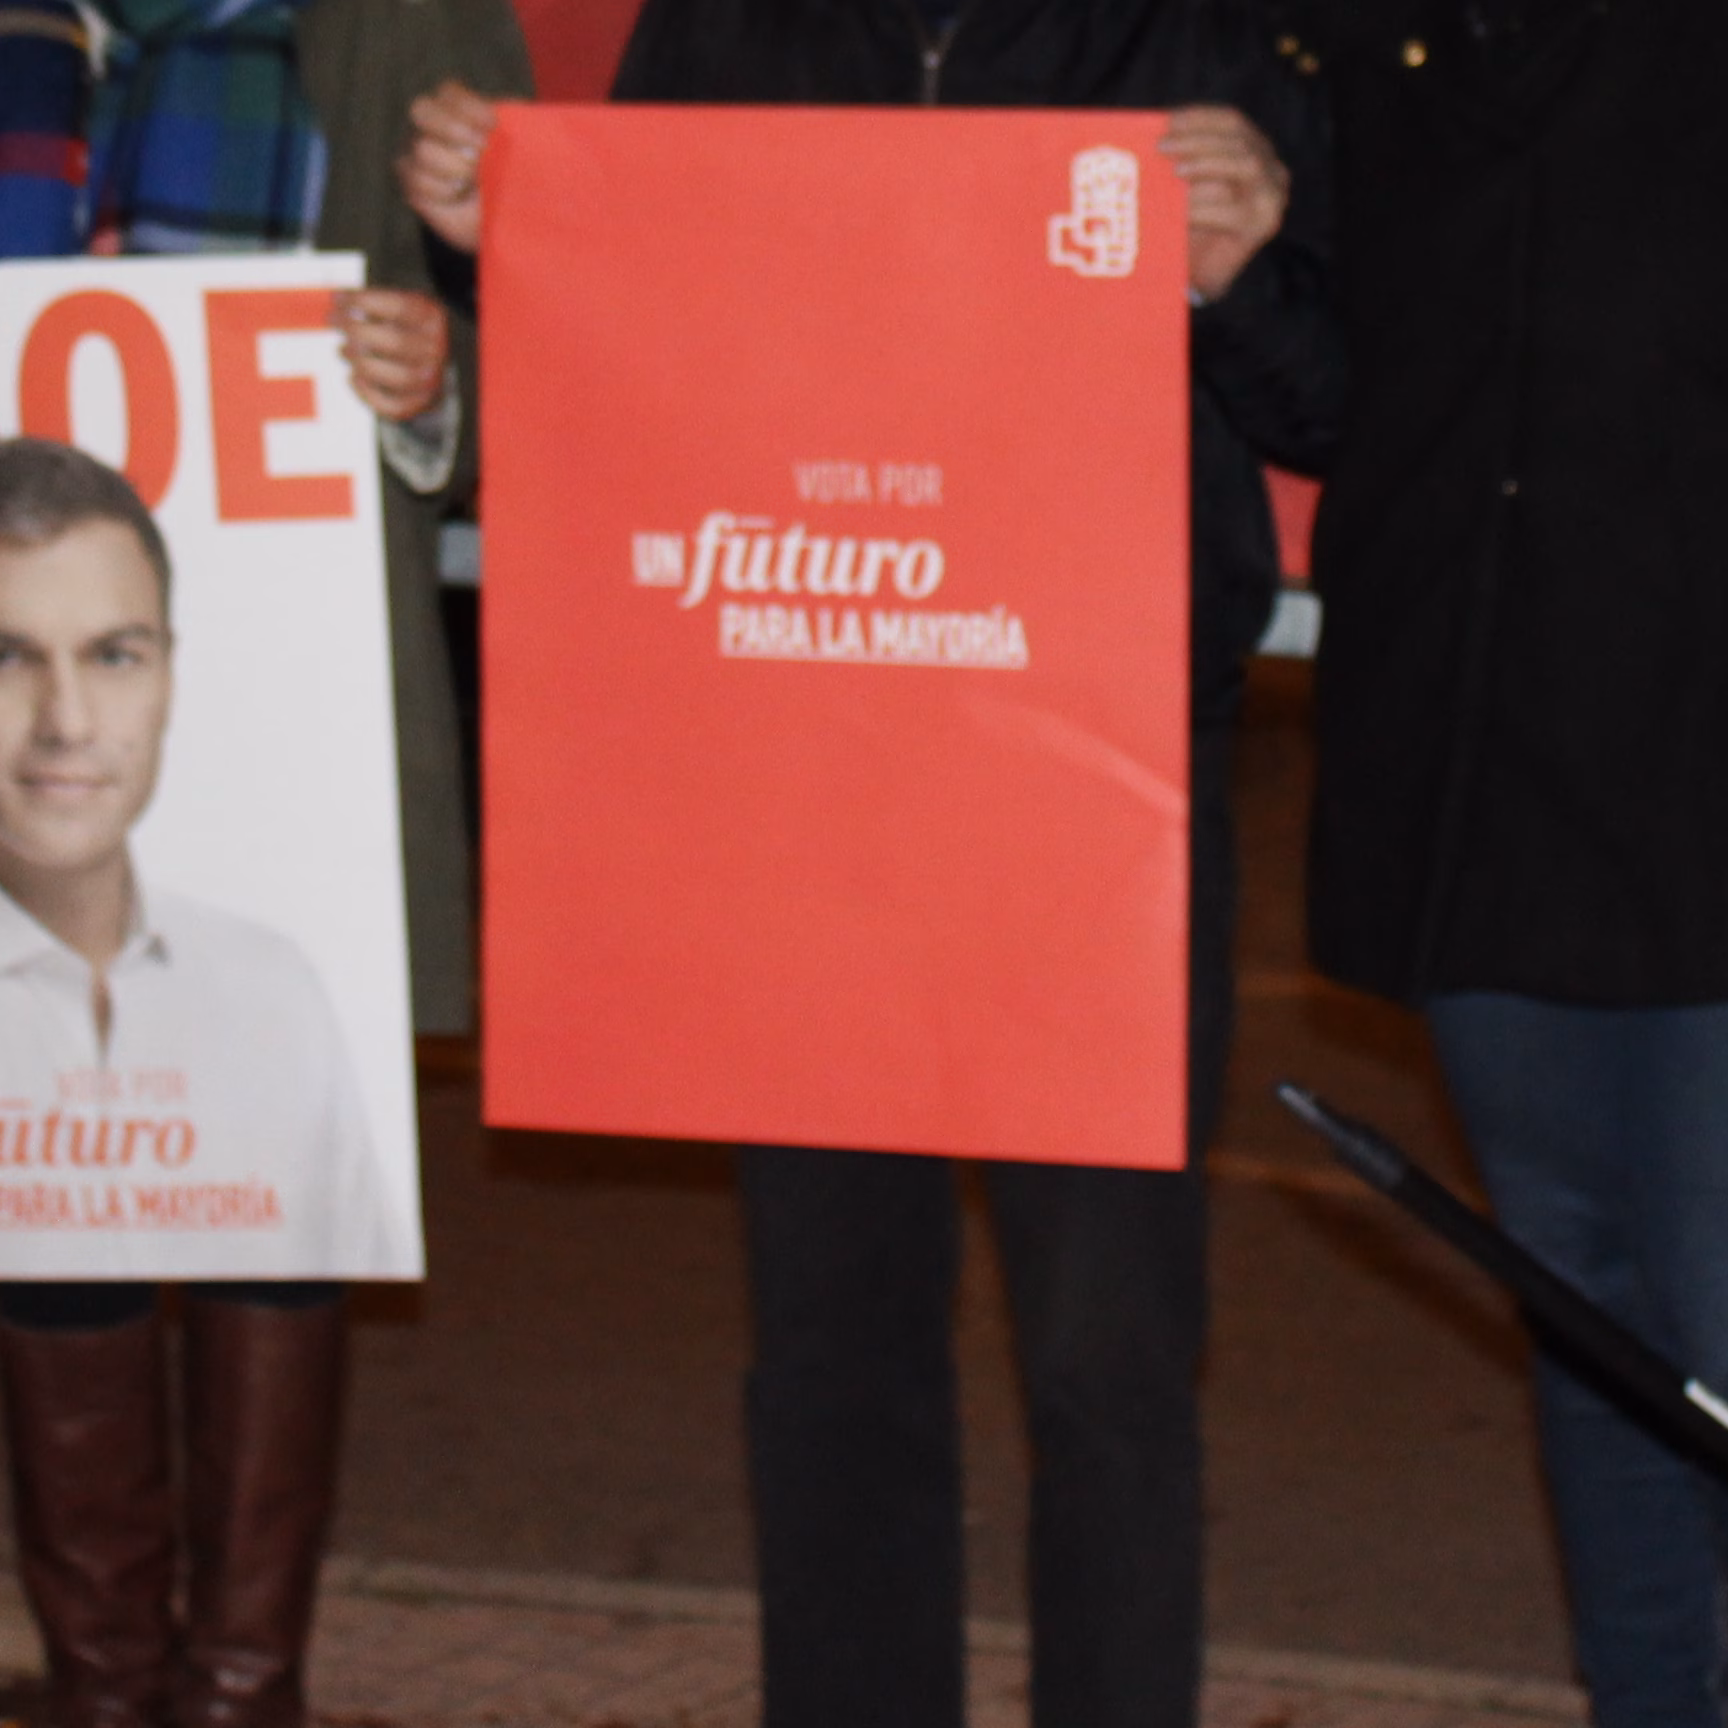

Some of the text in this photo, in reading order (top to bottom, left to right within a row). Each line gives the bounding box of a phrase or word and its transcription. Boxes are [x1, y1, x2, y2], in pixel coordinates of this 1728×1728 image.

[794, 460, 943, 507] VOTA POR
[632, 529, 685, 587] UN
[720, 602, 1029, 669] PARA LA MAYORÍA
[79, 1182, 125, 1227] LA
